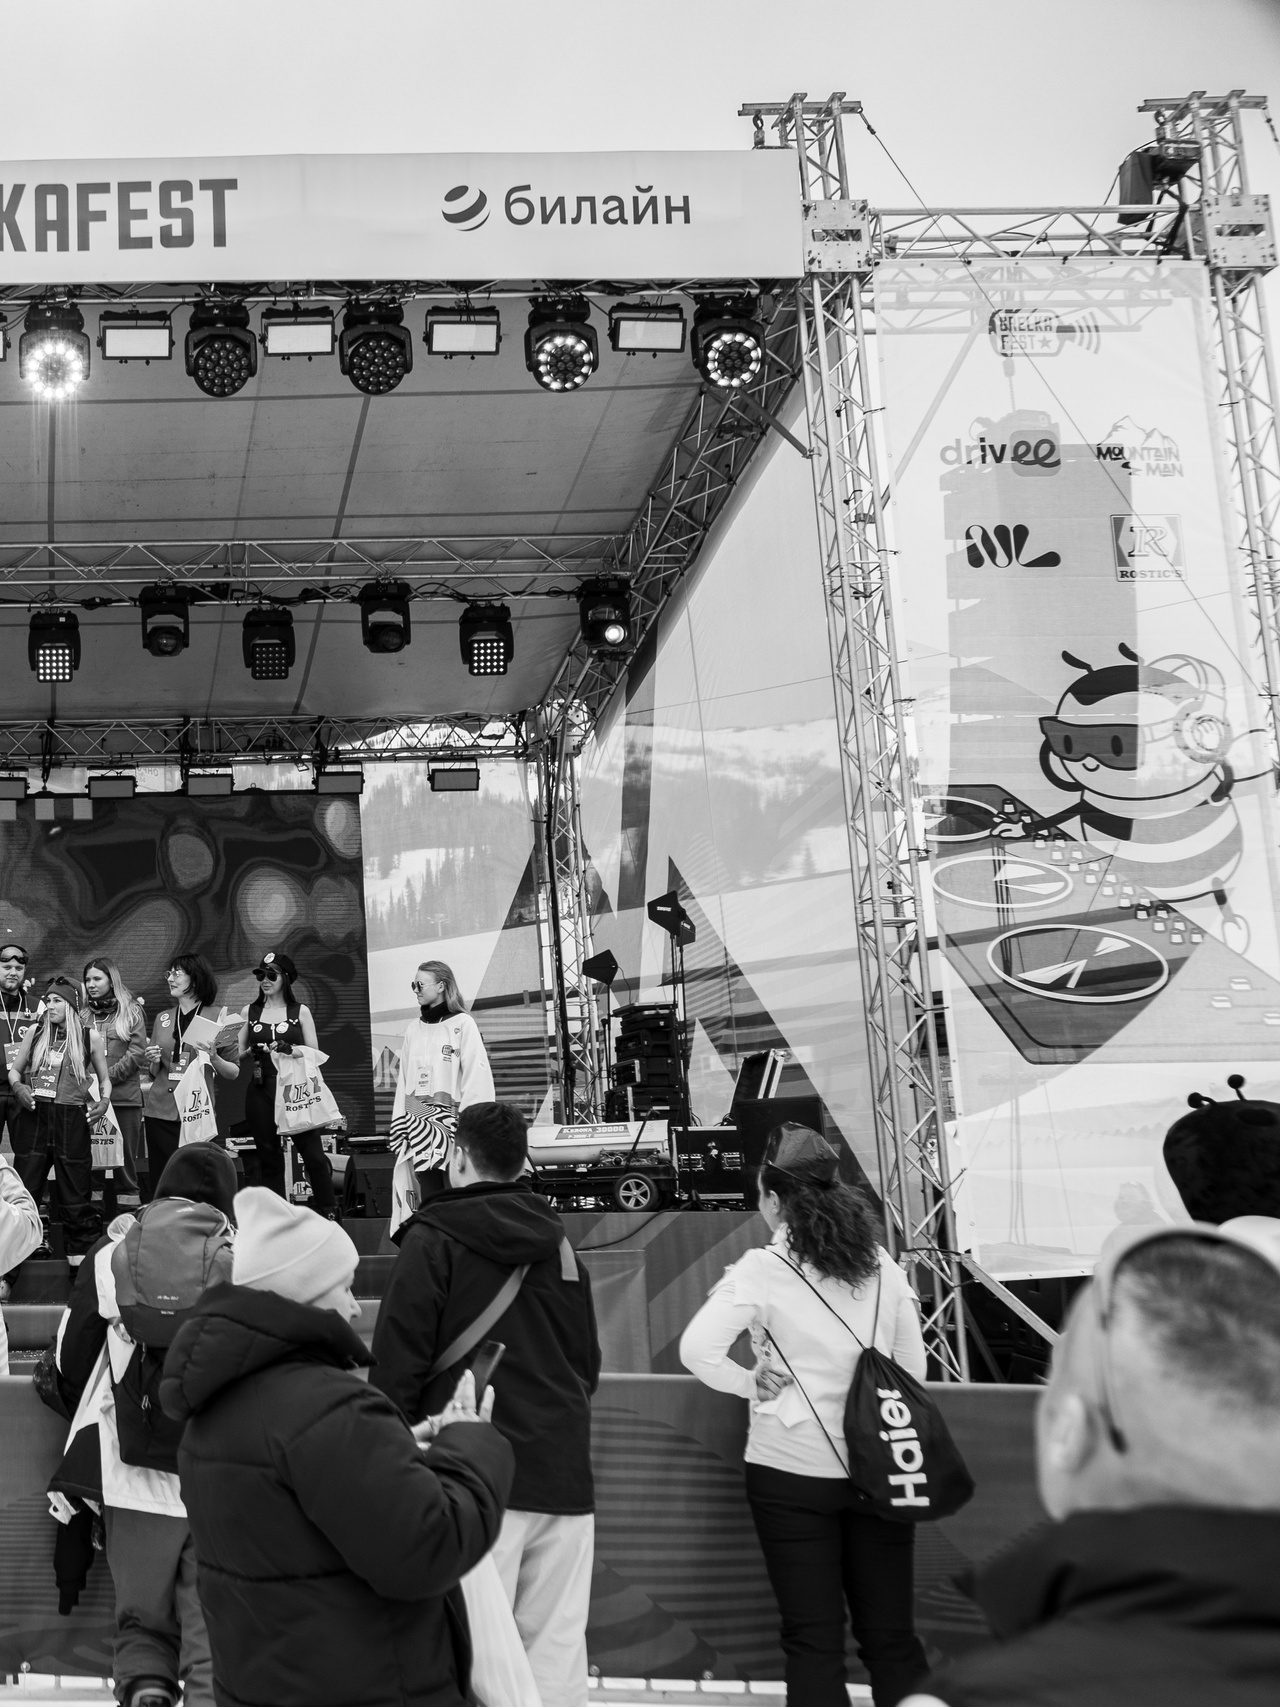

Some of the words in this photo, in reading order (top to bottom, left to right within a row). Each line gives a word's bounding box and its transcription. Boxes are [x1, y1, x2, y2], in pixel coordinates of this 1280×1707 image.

[504, 184, 691, 225] билайн
[939, 437, 1062, 468] drivee
[1096, 446, 1181, 462] MOUNTAIN
[1145, 463, 1184, 477] MAN
[1119, 568, 1184, 579] ROSTIC'S
[596, 1125, 625, 1133] 30000
[876, 1387, 931, 1507] Haier
